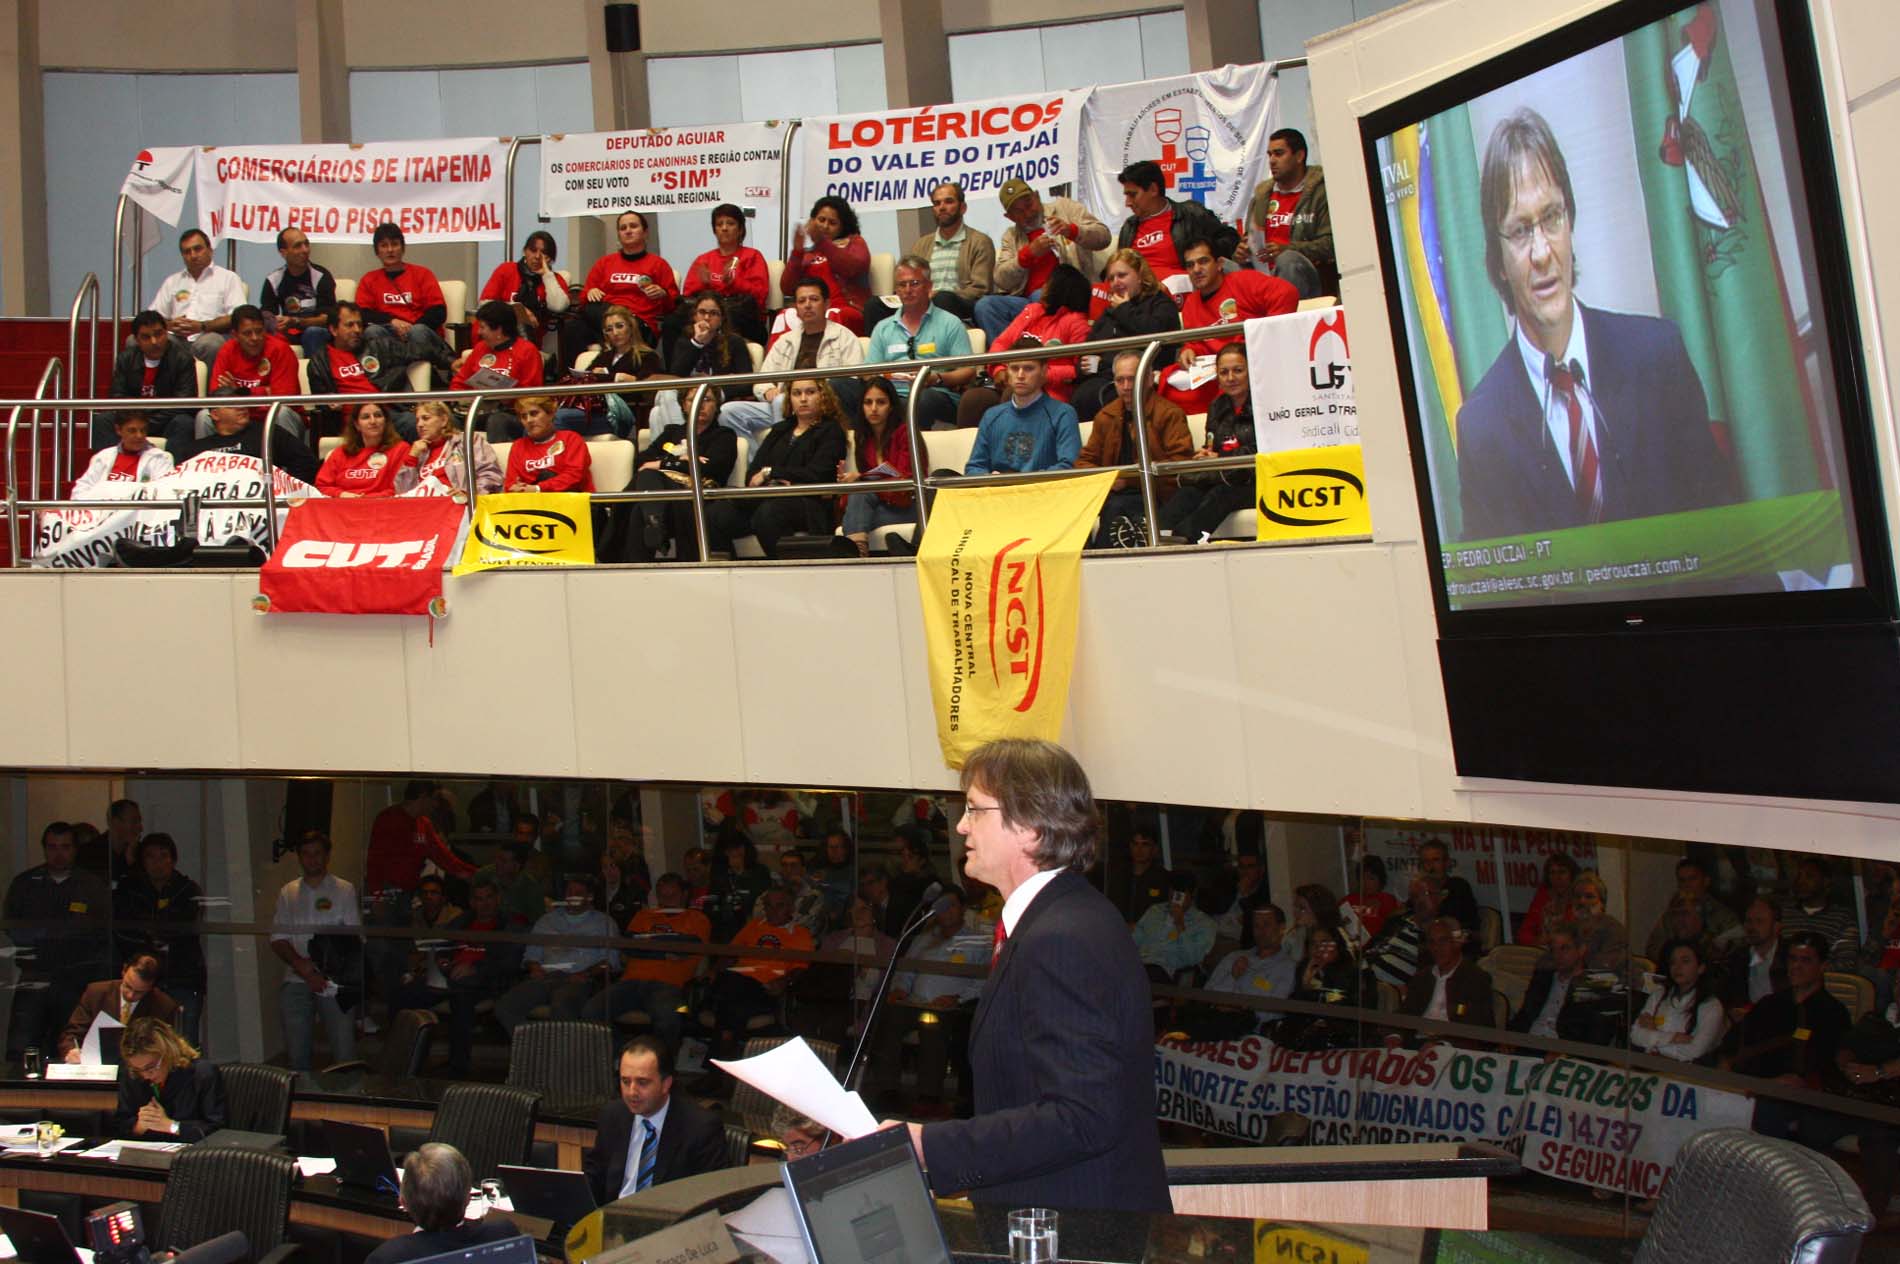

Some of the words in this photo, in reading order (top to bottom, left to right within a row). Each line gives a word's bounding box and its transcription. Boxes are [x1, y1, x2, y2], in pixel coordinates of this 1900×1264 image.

[828, 97, 1064, 150] LOTÉRICOS
[606, 134, 673, 150] DEPUTADO
[677, 131, 725, 146] AGUIAR
[828, 157, 862, 175] DO
[872, 151, 935, 171] VALE
[945, 147, 979, 165] DO
[987, 122, 1058, 160] ITAJAÍ
[217, 154, 366, 184] COMERCIÁRIOS
[371, 158, 399, 183] DE
[404, 154, 492, 183] ITAPEMA
[551, 163, 563, 173] OS
[633, 159, 644, 169] DE
[647, 155, 698, 168] CANOINHAS
[700, 154, 706, 164] E
[708, 149, 741, 164] REGIÃO
[743, 150, 780, 161] CONTAM
[565, 180, 585, 191] COM
[587, 178, 603, 189] SEU
[606, 177, 629, 188] VOTO
[827, 179, 908, 203] CONFIAM
[959, 154, 1060, 193] DEPUTADOS
[587, 197, 609, 208] PELO
[611, 196, 632, 207] PISO
[634, 193, 675, 206] SALARIAL
[678, 191, 721, 203] REGIONAL
[230, 203, 281, 232] LUTA
[288, 207, 340, 233] PELO
[346, 208, 393, 234] PISO
[401, 203, 501, 234] ESTADUAL
[1278, 486, 1345, 509] NCST
[494, 524, 558, 540] NCST
[282, 539, 424, 568] CUT
[951, 529, 972, 584] SINDICAL
[1457, 548, 1491, 567] PEDRO
[1536, 540, 1552, 559] PT
[951, 589, 960, 606] DE
[965, 572, 973, 609] NOVA
[1006, 561, 1029, 680] NCST
[964, 614, 976, 679] CENTRAL
[950, 610, 963, 732] TRABALHADORES
[1284, 1079, 1350, 1119] ESTÃO
[1662, 1083, 1697, 1120] DA
